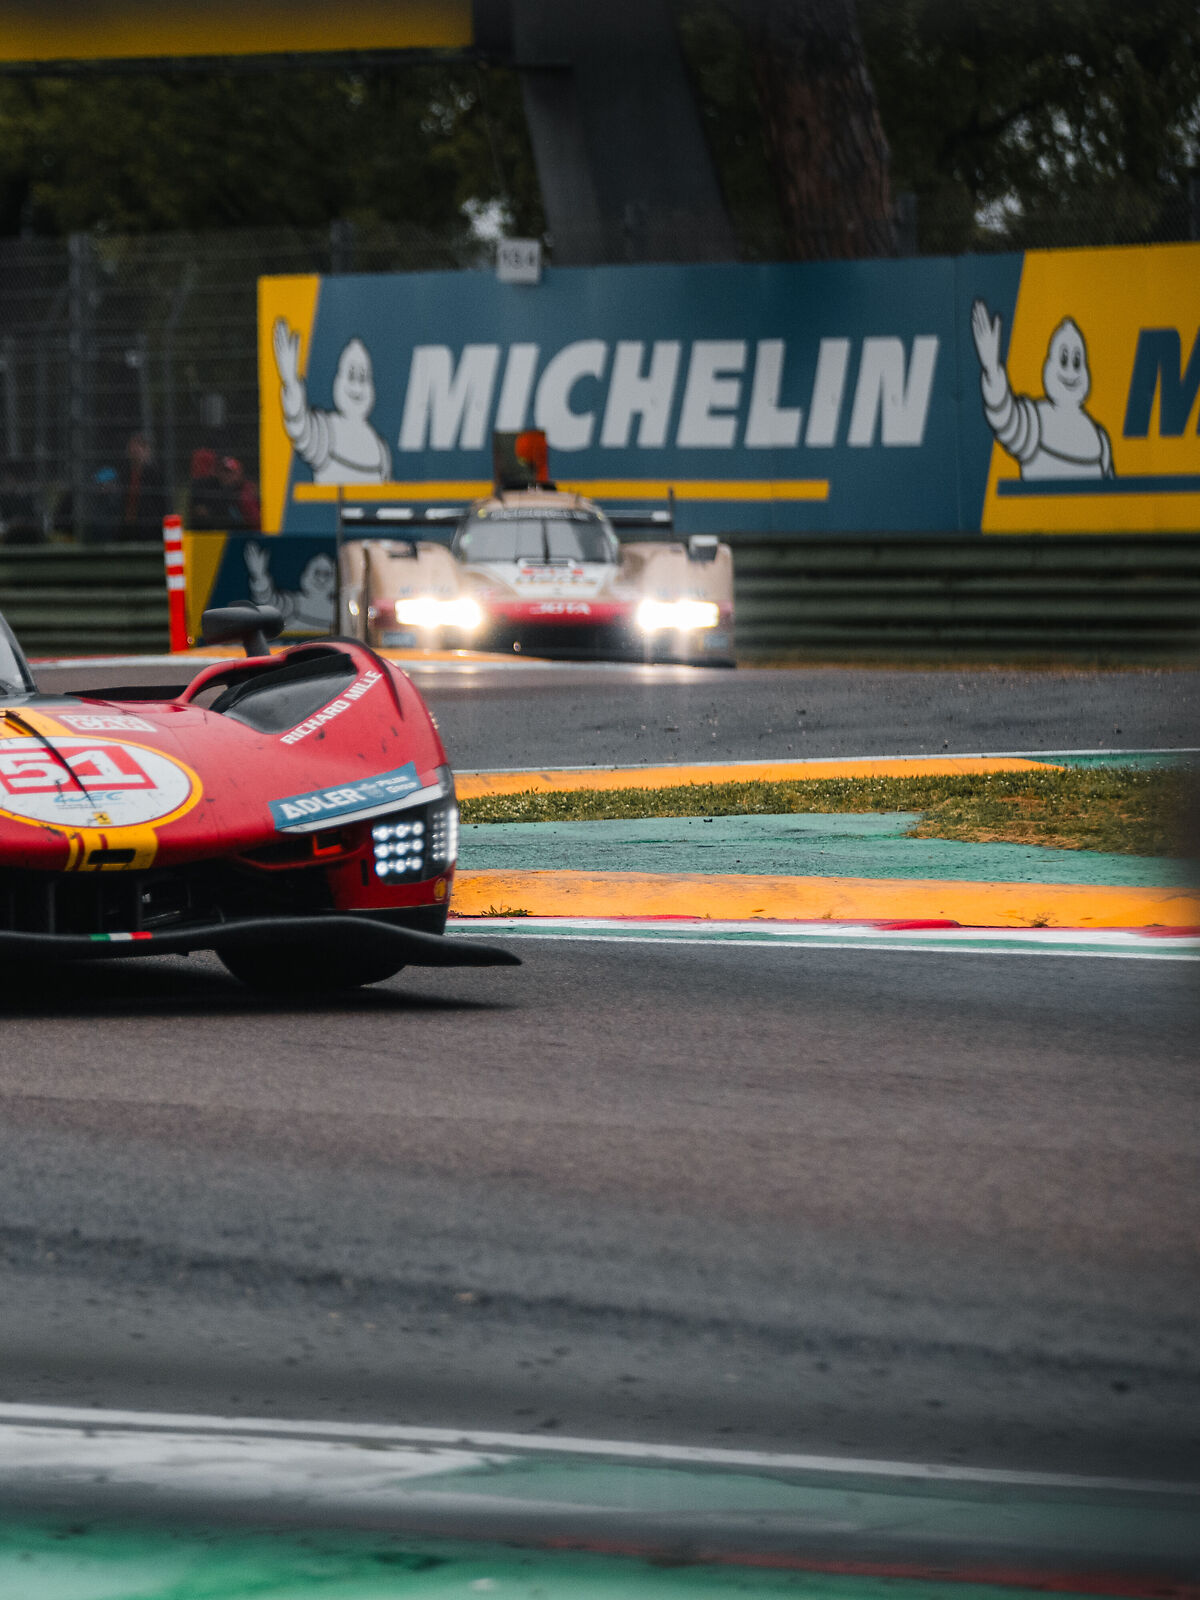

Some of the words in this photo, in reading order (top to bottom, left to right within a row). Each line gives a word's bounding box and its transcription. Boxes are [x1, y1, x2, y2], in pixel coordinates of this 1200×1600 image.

[398, 336, 939, 451] MICHELIN
[280, 699, 351, 745] RICHARD
[344, 670, 383, 701] MILLE
[280, 788, 367, 819] ADLER
